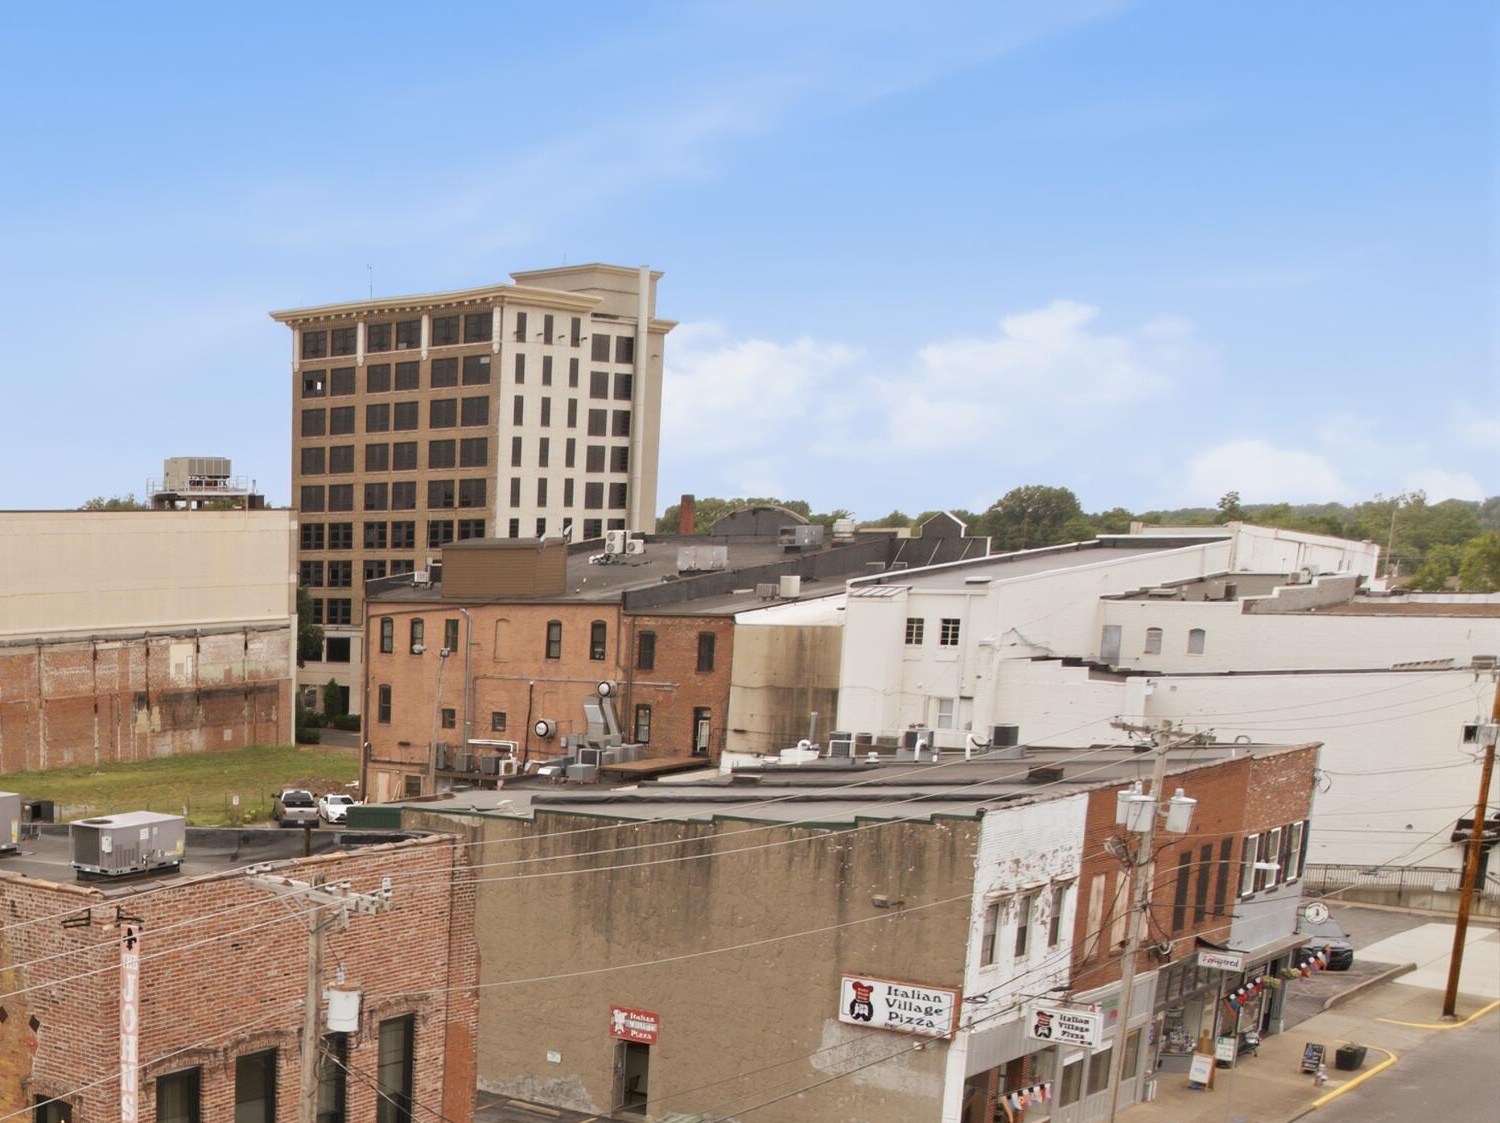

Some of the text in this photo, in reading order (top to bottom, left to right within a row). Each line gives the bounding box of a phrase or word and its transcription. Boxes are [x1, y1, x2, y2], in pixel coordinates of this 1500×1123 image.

[887, 986, 943, 1003] Italian
[885, 998, 943, 1017] Village
[888, 1011, 935, 1028] Pizza
[1058, 1021, 1090, 1033] Village
